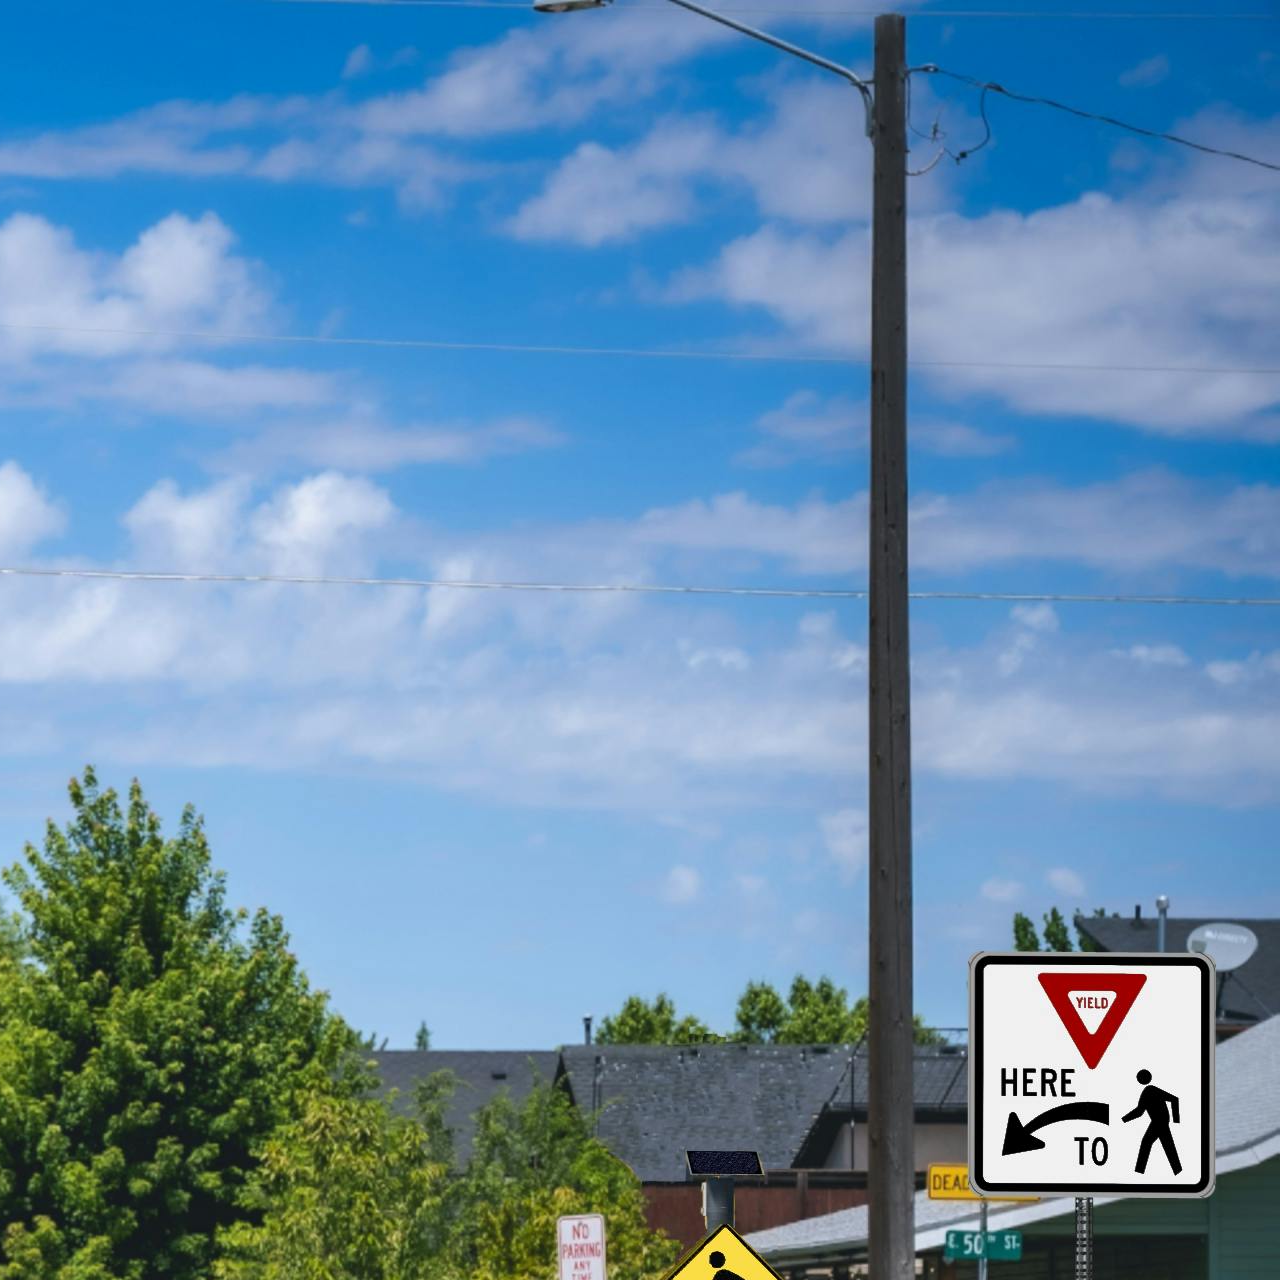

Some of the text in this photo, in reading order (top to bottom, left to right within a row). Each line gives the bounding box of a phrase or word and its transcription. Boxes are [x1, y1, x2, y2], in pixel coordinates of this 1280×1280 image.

[1076, 997, 1108, 1009] YIELD
[1001, 1068, 1075, 1096] HERE
[1074, 1137, 1108, 1166] TO
[572, 1223, 589, 1239] NO
[562, 1242, 601, 1258] PARKING
[574, 1261, 591, 1271] ANY
